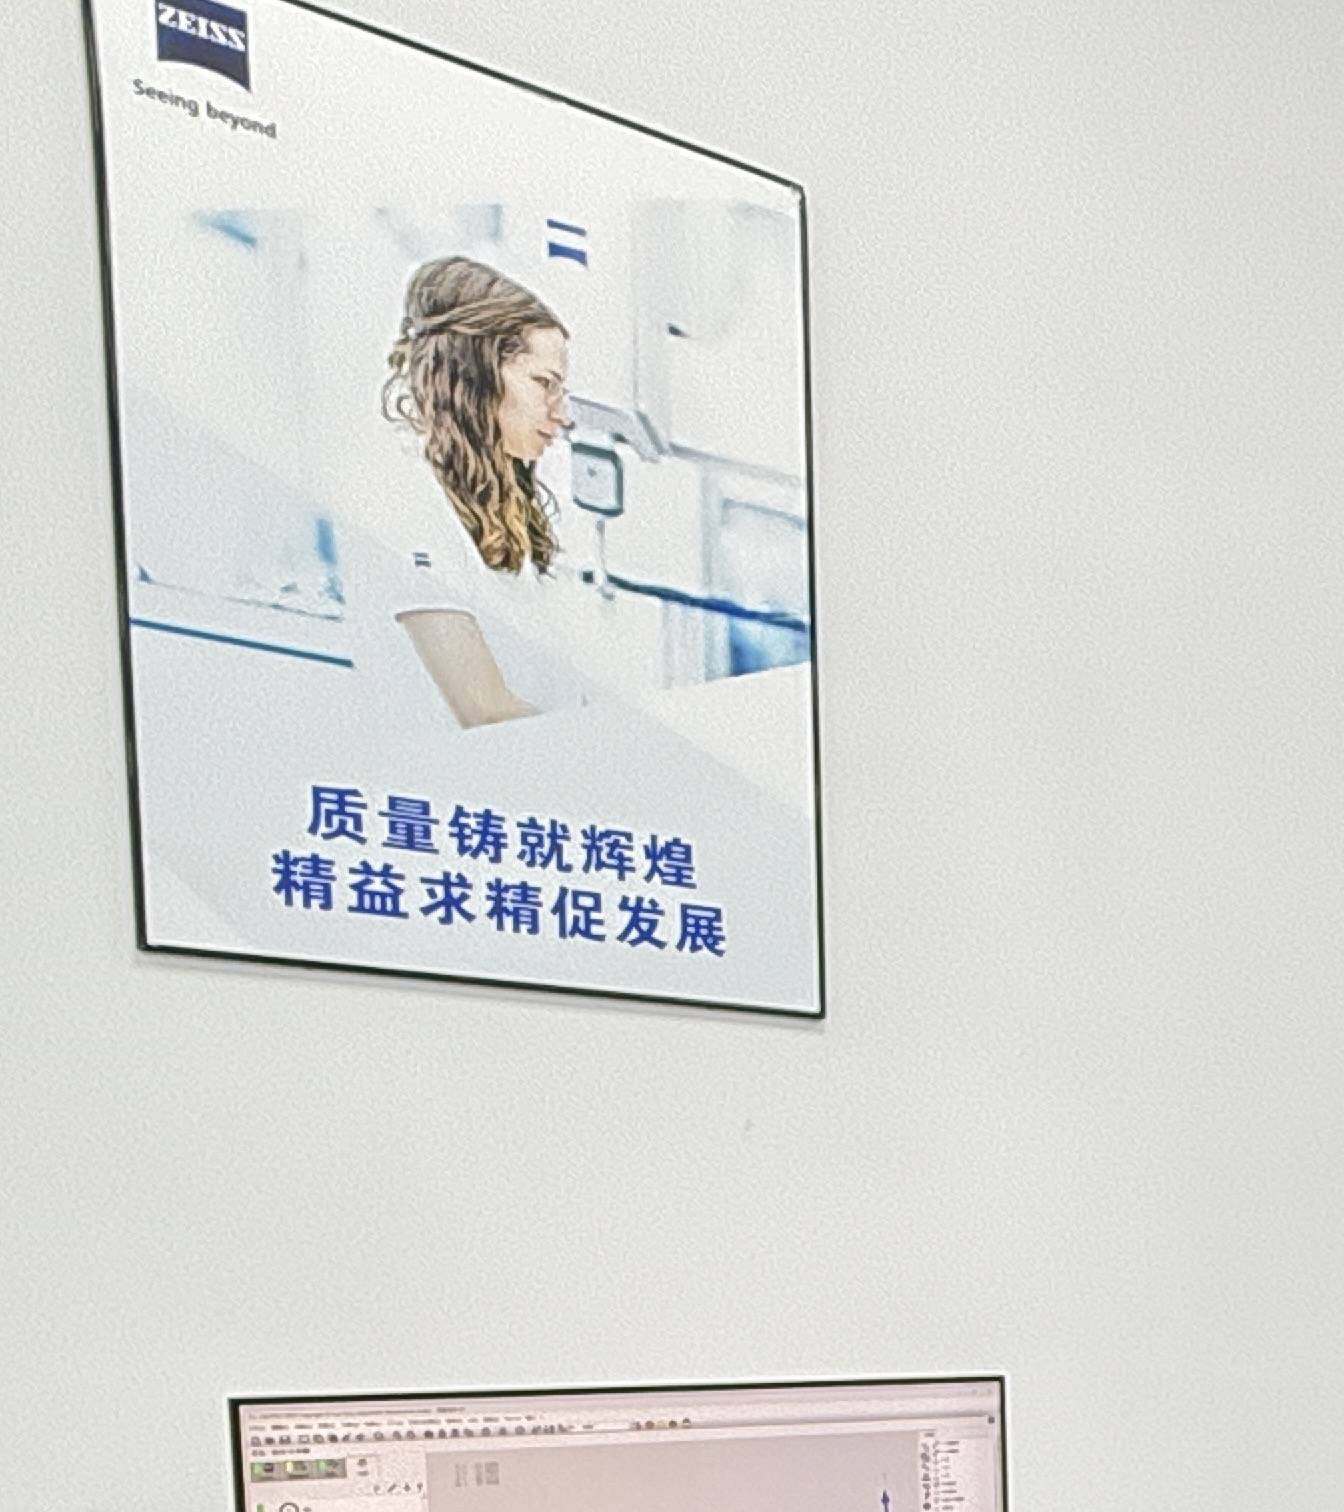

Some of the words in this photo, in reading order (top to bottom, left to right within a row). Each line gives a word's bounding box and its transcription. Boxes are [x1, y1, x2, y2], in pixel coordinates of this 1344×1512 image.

[158, 2, 246, 52] ZEISS
[132, 78, 199, 118] Seeing
[206, 99, 277, 140] beyond
[306, 784, 698, 890] 质量铸就辉煌
[271, 848, 727, 958] 精益求精促发展
